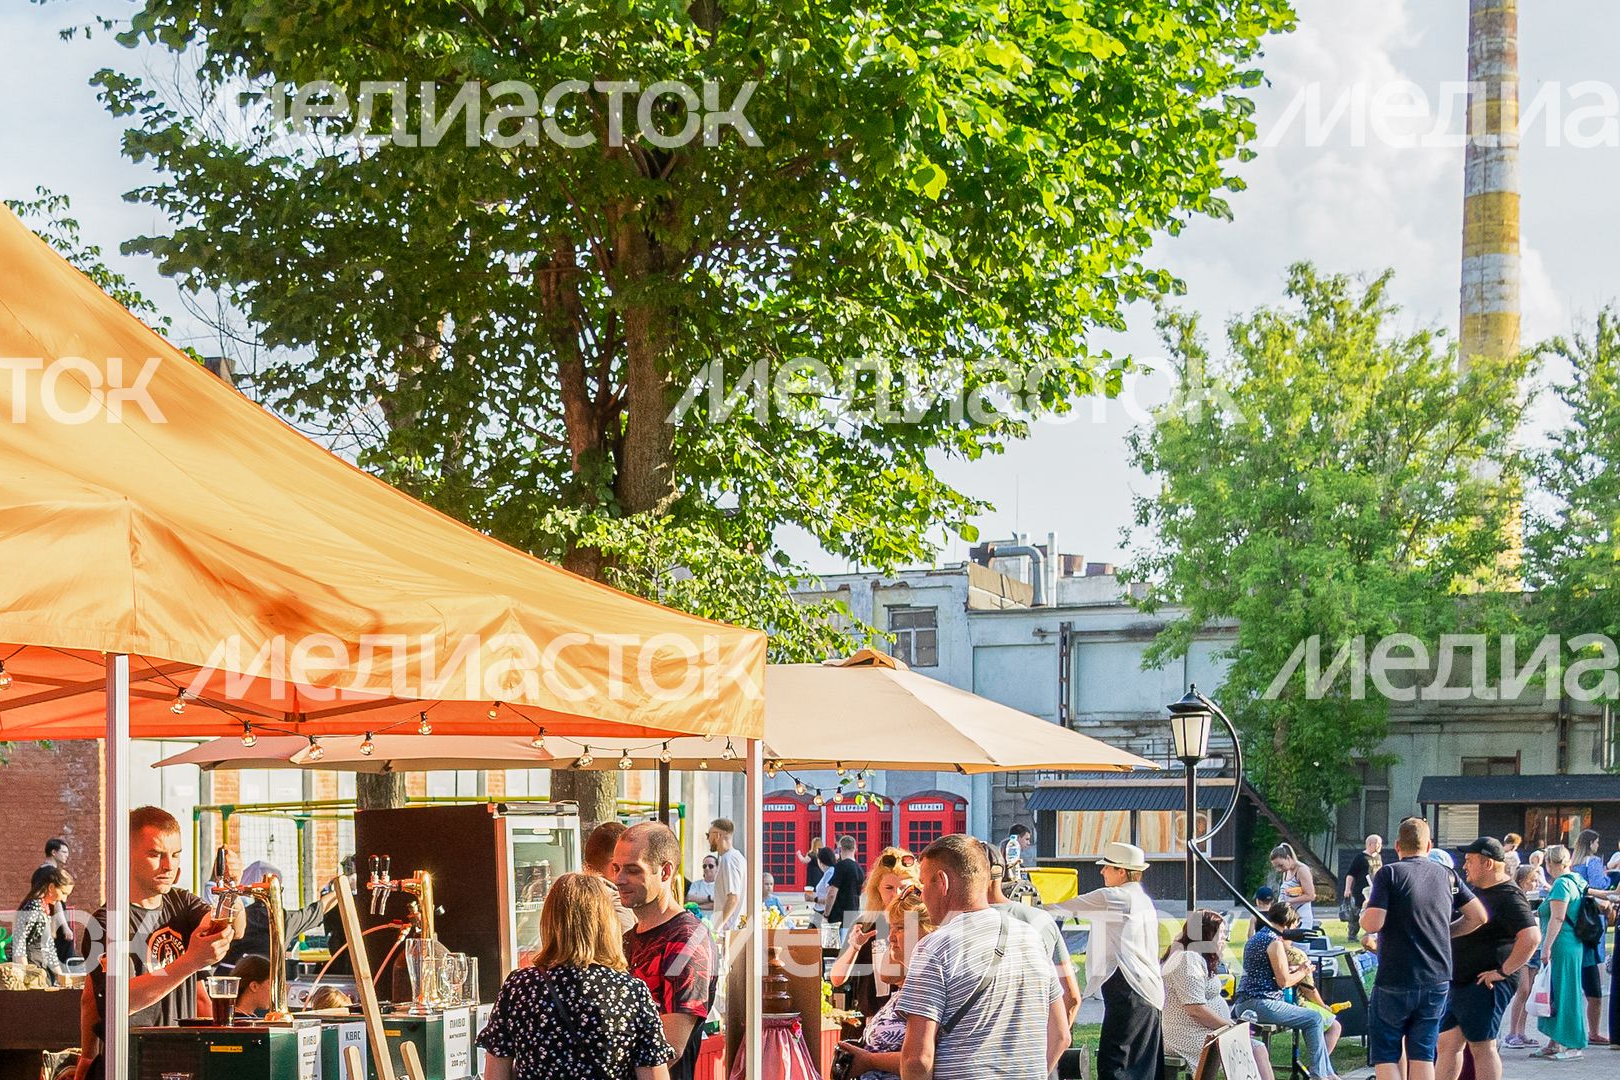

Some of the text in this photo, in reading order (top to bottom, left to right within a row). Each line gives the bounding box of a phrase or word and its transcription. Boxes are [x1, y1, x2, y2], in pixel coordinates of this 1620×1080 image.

[764, 803, 795, 811] ELEPHONE
[909, 803, 943, 811] TELEPHONE
[345, 1031, 361, 1041] КВАС
